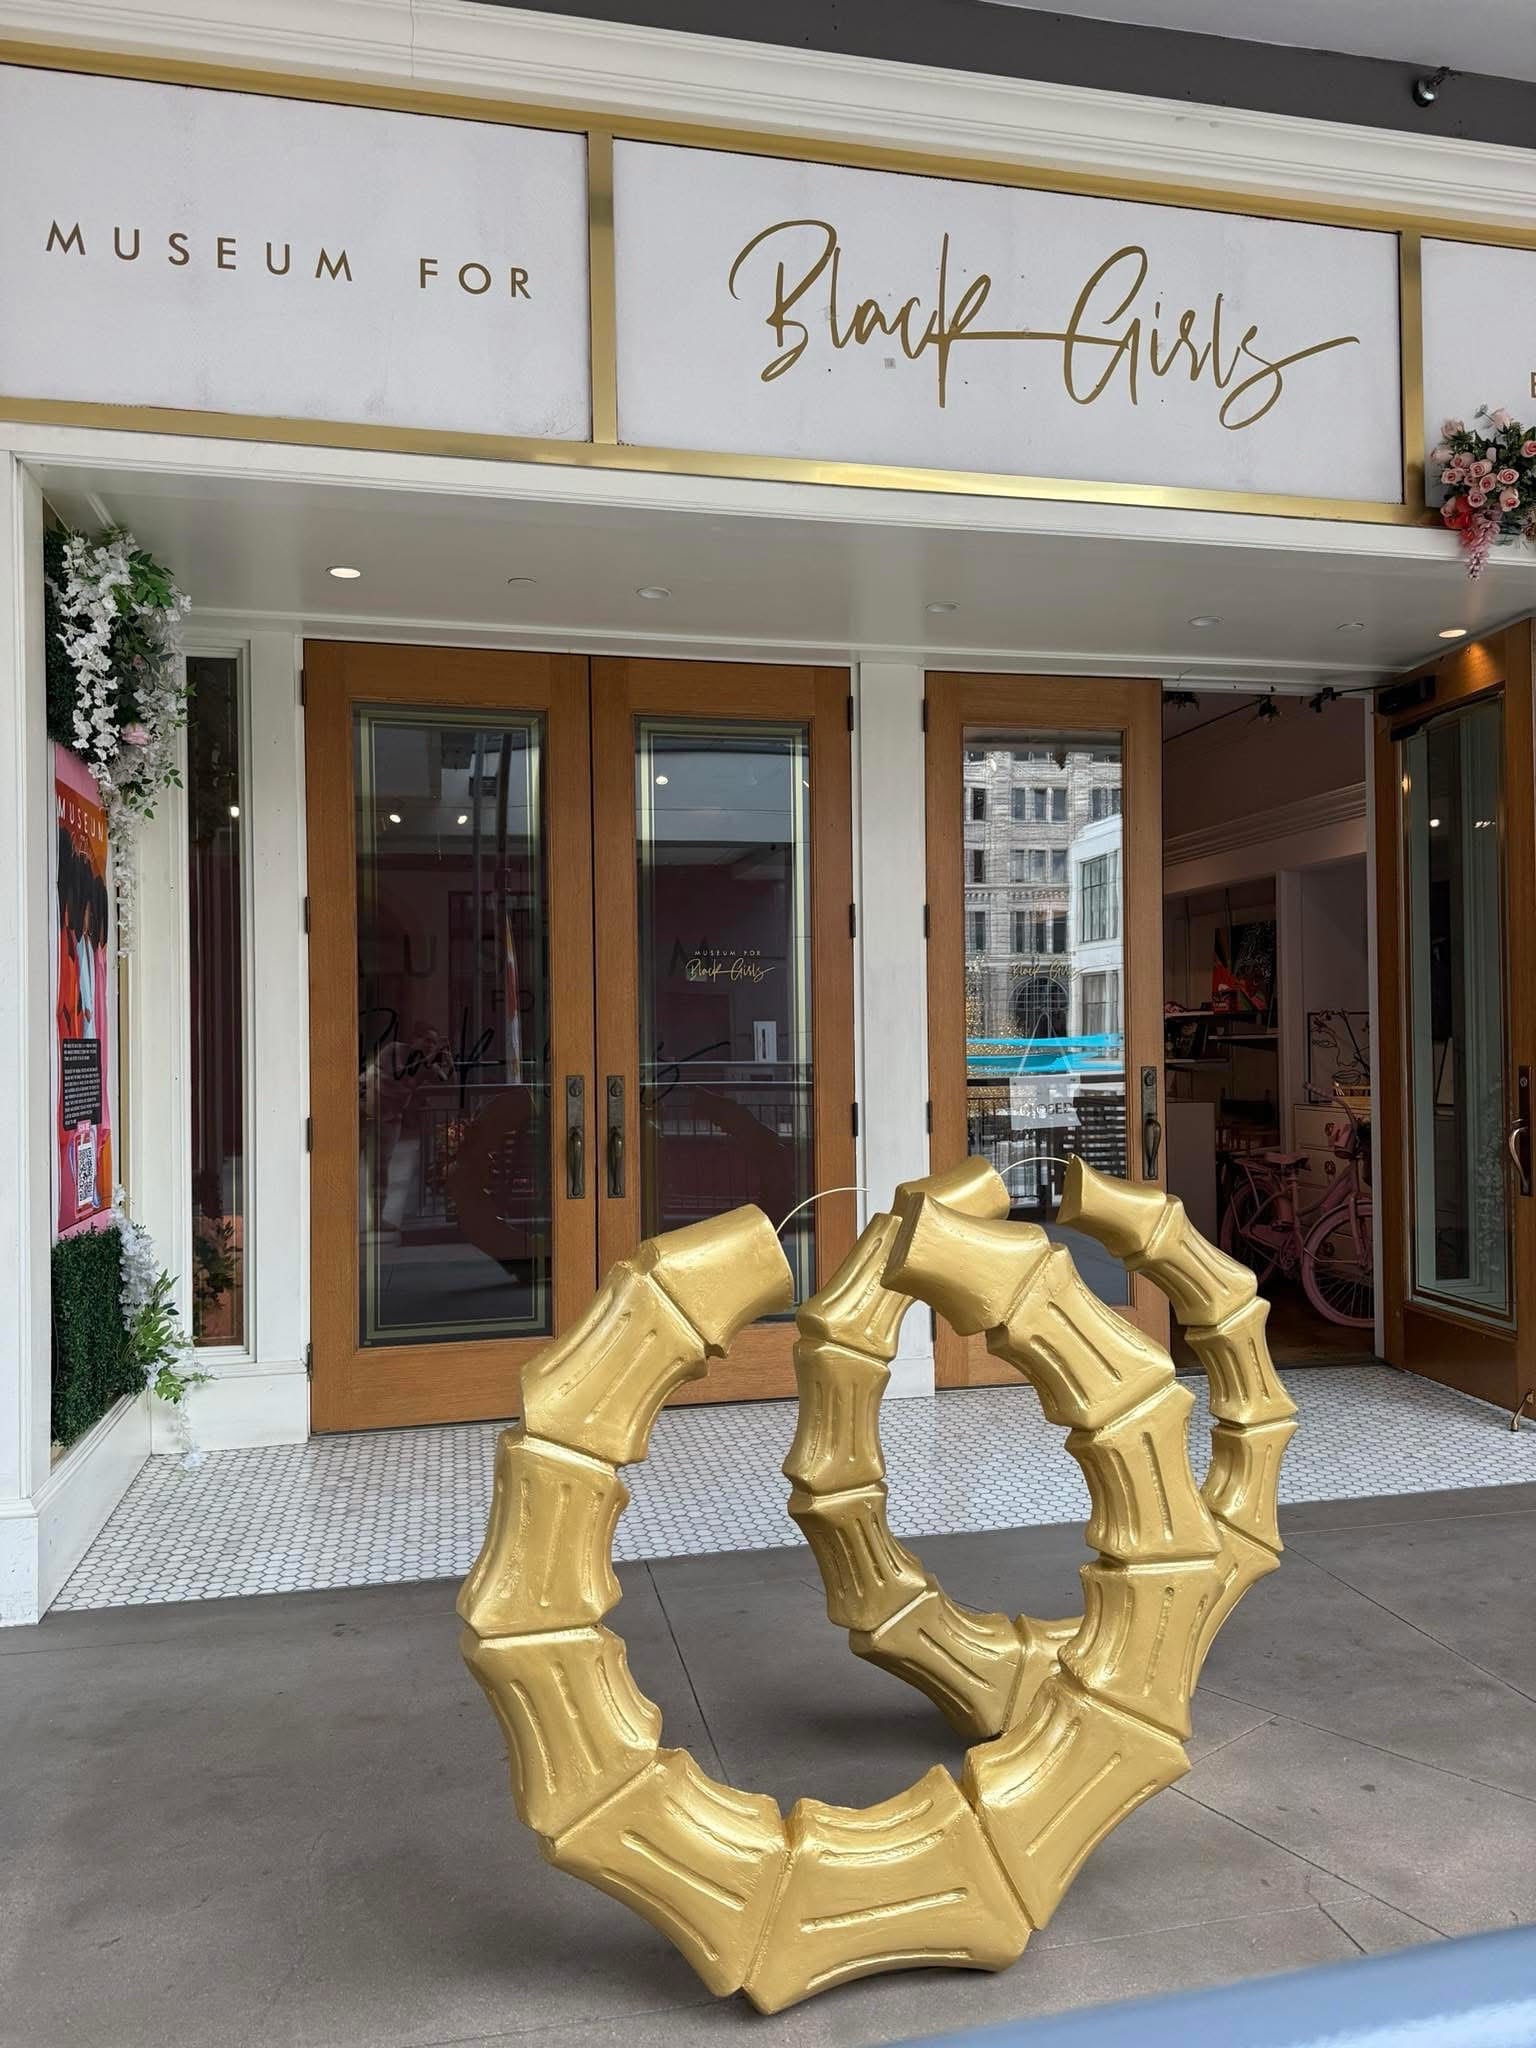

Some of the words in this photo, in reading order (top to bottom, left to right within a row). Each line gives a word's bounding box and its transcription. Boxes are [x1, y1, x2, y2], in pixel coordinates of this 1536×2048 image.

[45, 220, 352, 282] MUSEUM
[419, 258, 532, 299] FOR
[729, 219, 1064, 408] Black
[1064, 245, 1360, 430] Girls
[685, 958, 724, 983] Black
[730, 957, 776, 983] Girls
